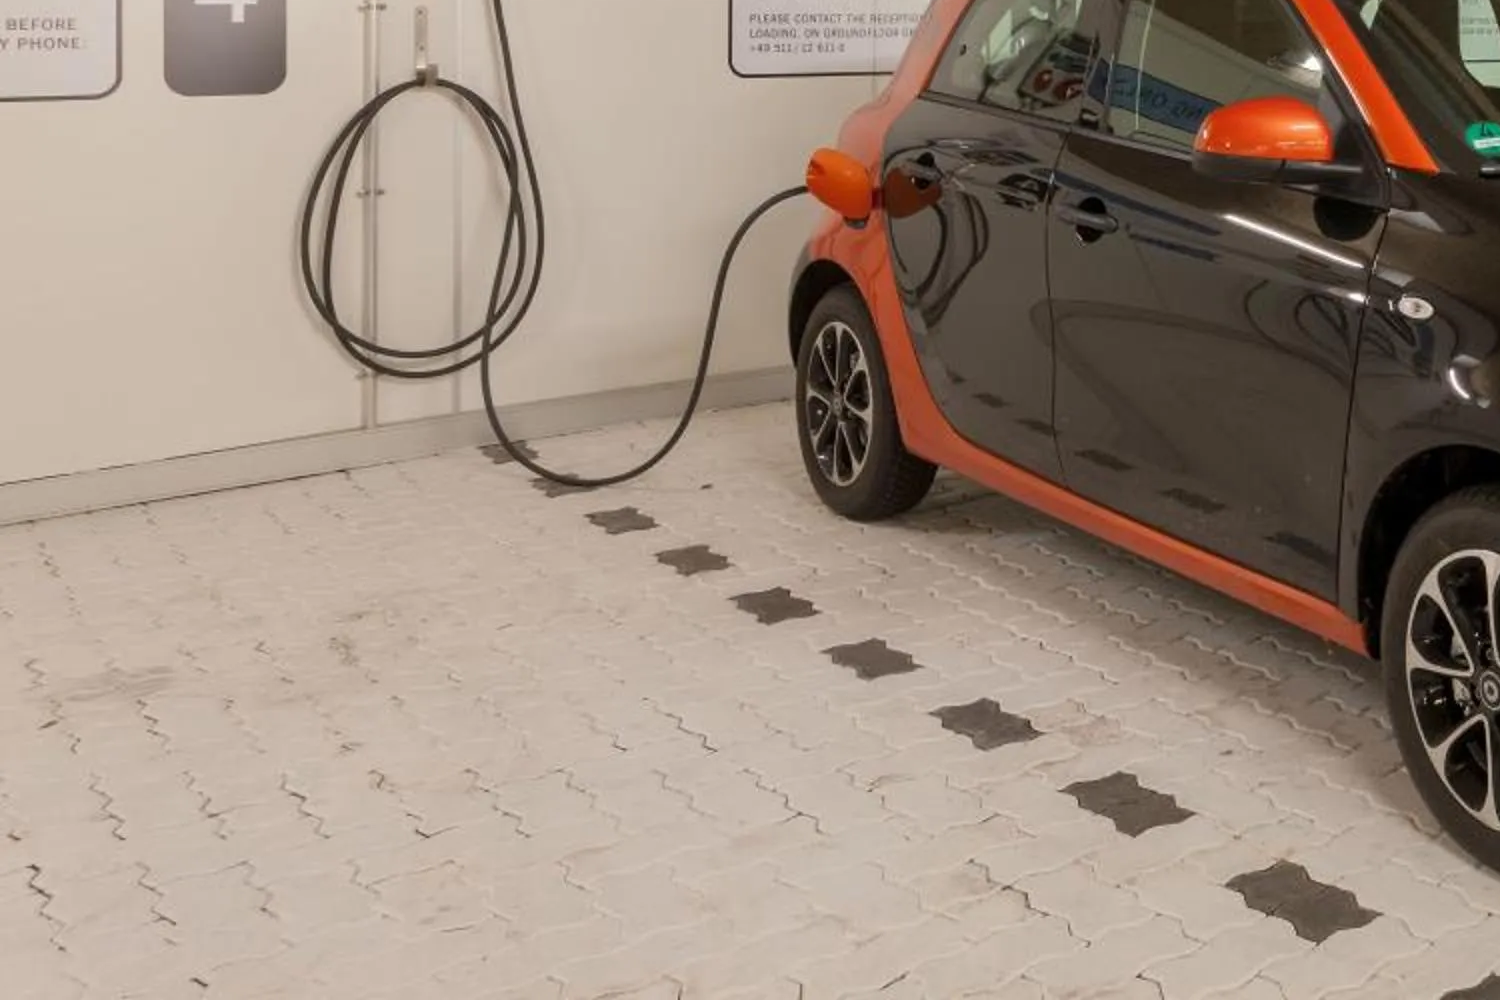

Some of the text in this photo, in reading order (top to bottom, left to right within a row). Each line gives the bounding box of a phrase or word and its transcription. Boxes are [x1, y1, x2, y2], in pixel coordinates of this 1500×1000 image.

[5, 17, 77, 31] BEFORE
[750, 12, 790, 25] PLEASE
[794, 12, 842, 25] CONTACT
